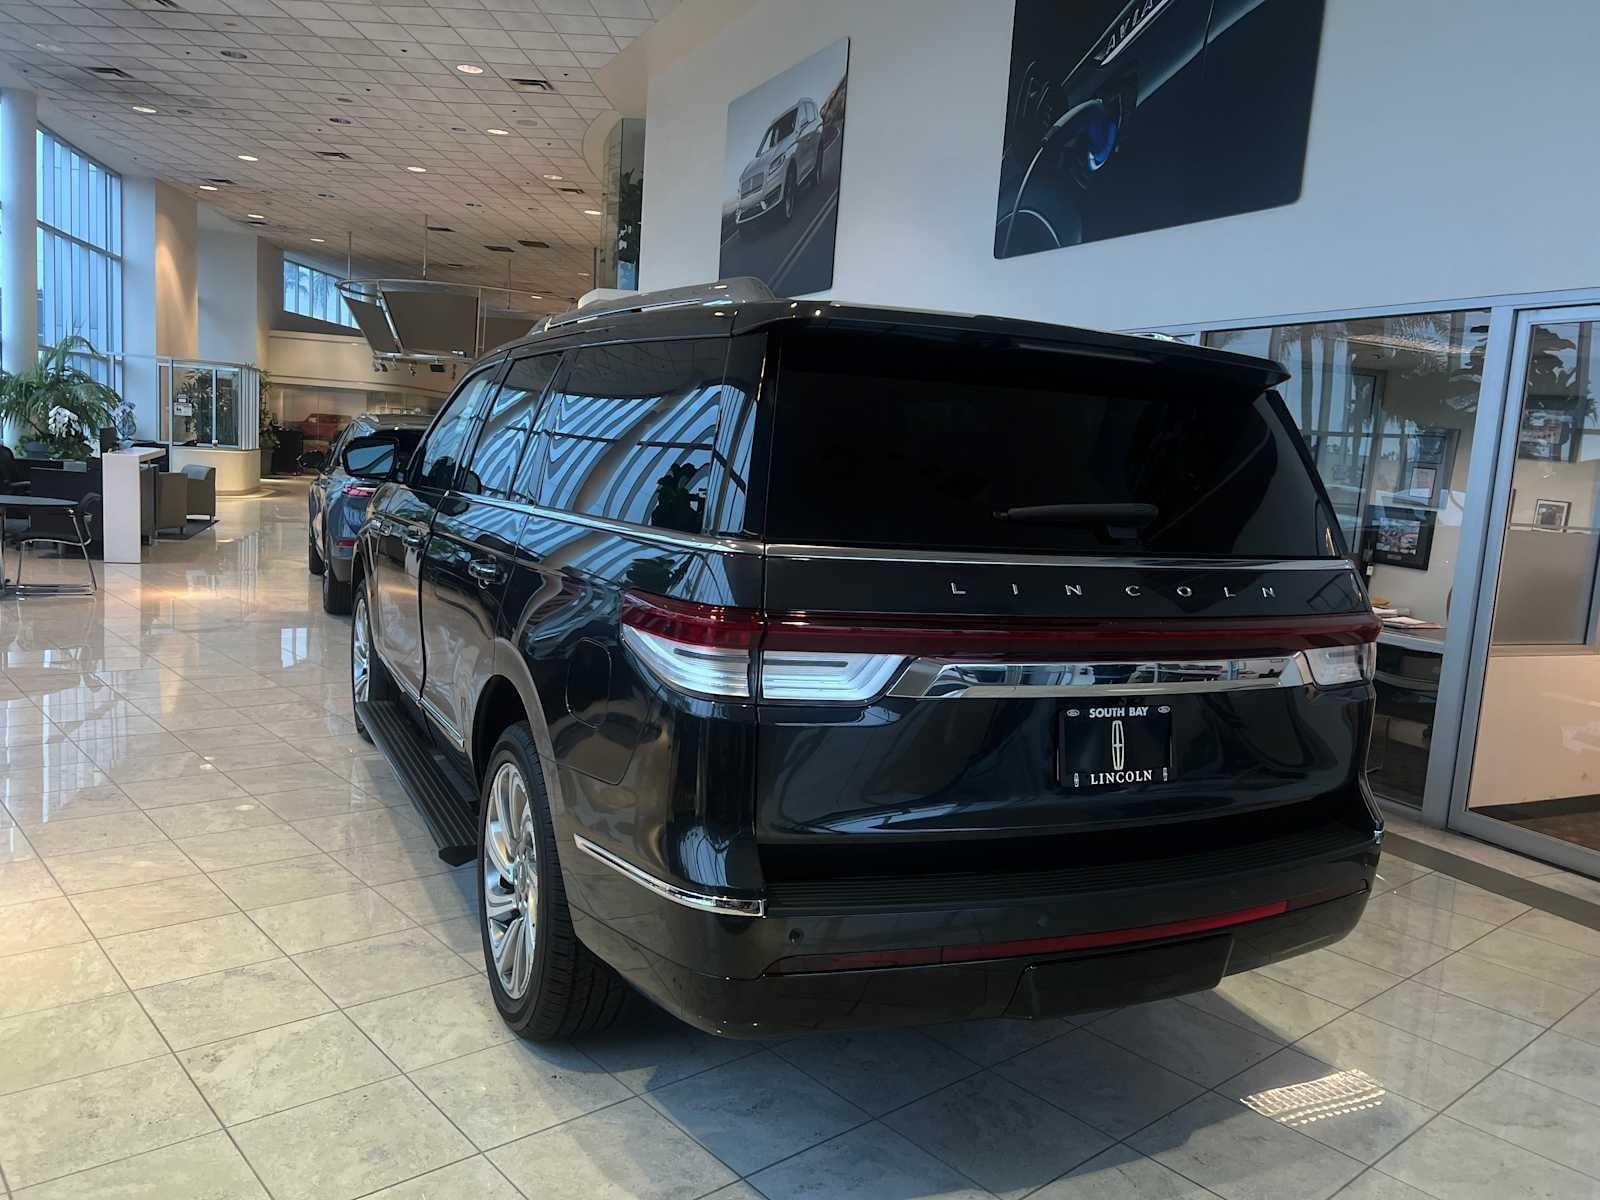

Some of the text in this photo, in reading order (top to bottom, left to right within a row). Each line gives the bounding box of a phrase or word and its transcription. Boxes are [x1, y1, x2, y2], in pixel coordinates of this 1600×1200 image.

[950, 581, 1277, 598] LINCOLN
[1089, 706, 1126, 718] SOUTH
[1128, 706, 1150, 717] BAY
[1090, 769, 1153, 785] LINCOLN
